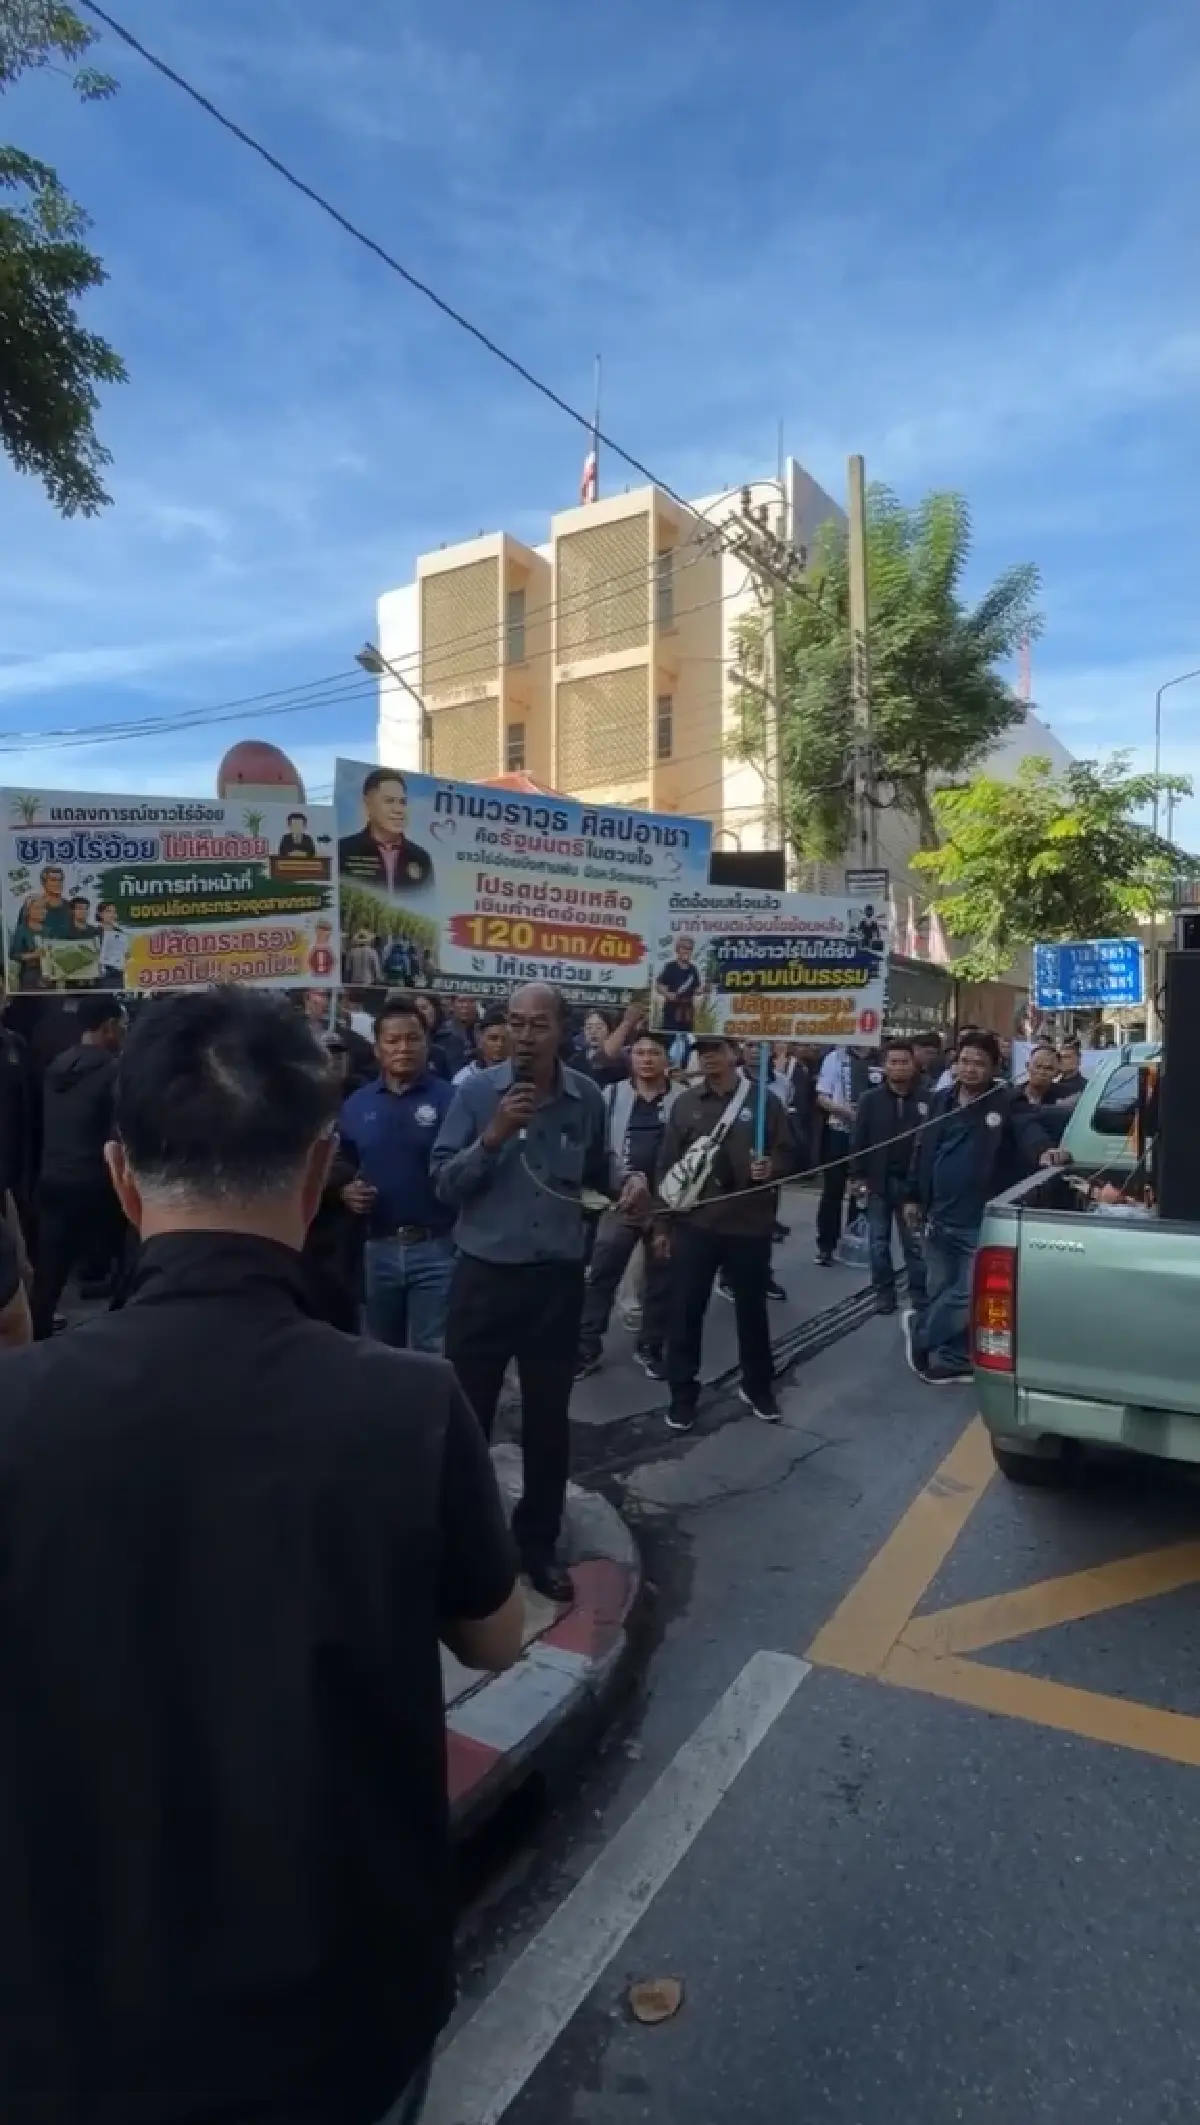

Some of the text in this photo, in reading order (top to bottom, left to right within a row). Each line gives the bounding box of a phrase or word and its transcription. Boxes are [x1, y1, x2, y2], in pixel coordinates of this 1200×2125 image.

[50, 804, 226, 822] แถลงการณ์ชาวไร่อ้อย
[434, 785, 690, 848] ท่านวราวุธ ศิลปอาชา
[15, 829, 270, 864] ชาวไร่อ้อย ไม่เห็นด้วย
[118, 867, 252, 897] กับการทำหน้าที่
[475, 872, 634, 911] โปรดช่วยเหลือ
[466, 918, 633, 960] 120 บาท/ตัน
[495, 954, 592, 982] ให้เราด้วย
[724, 958, 870, 989] ความเป็นธรรม
